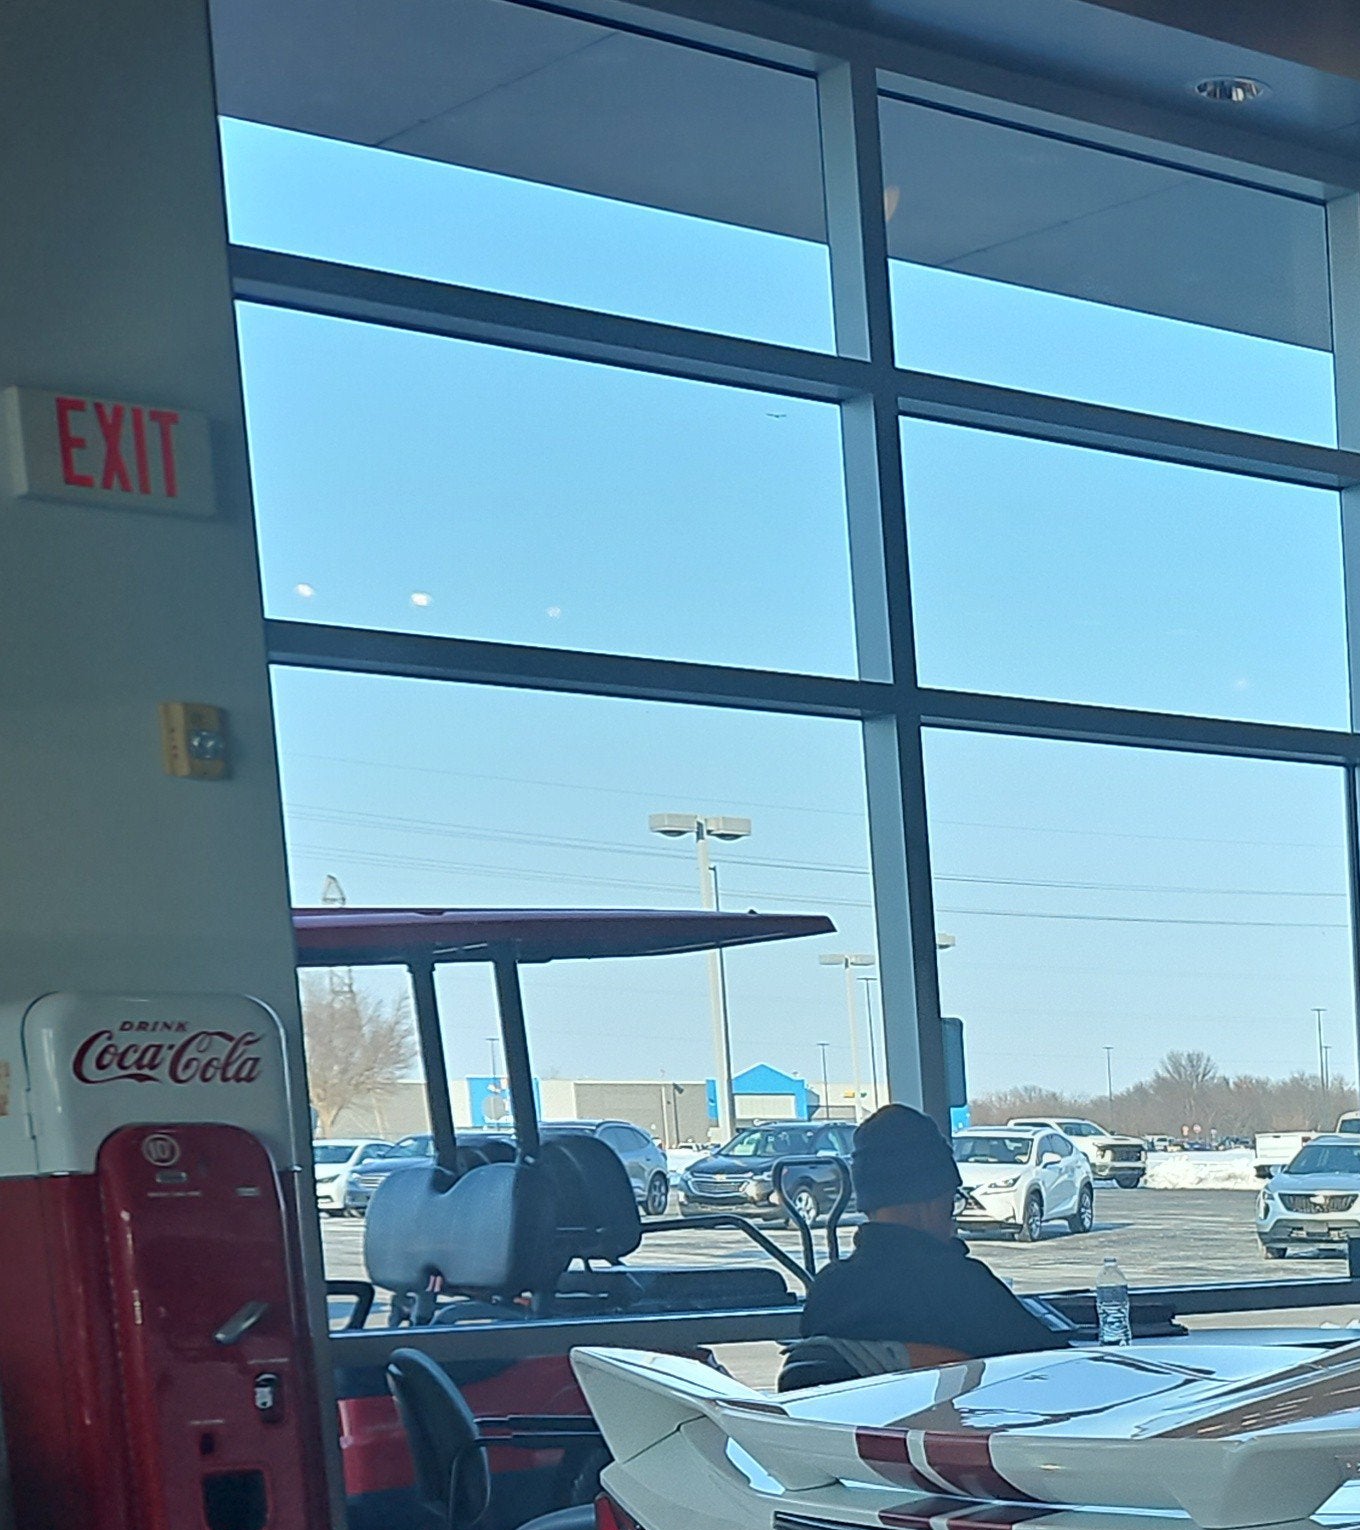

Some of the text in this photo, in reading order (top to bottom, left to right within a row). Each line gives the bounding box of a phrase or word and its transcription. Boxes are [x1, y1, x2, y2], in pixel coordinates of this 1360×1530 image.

[55, 396, 180, 498] EXIT
[119, 1020, 190, 1033] DRINK
[72, 1029, 263, 1085] Coca-Cola
